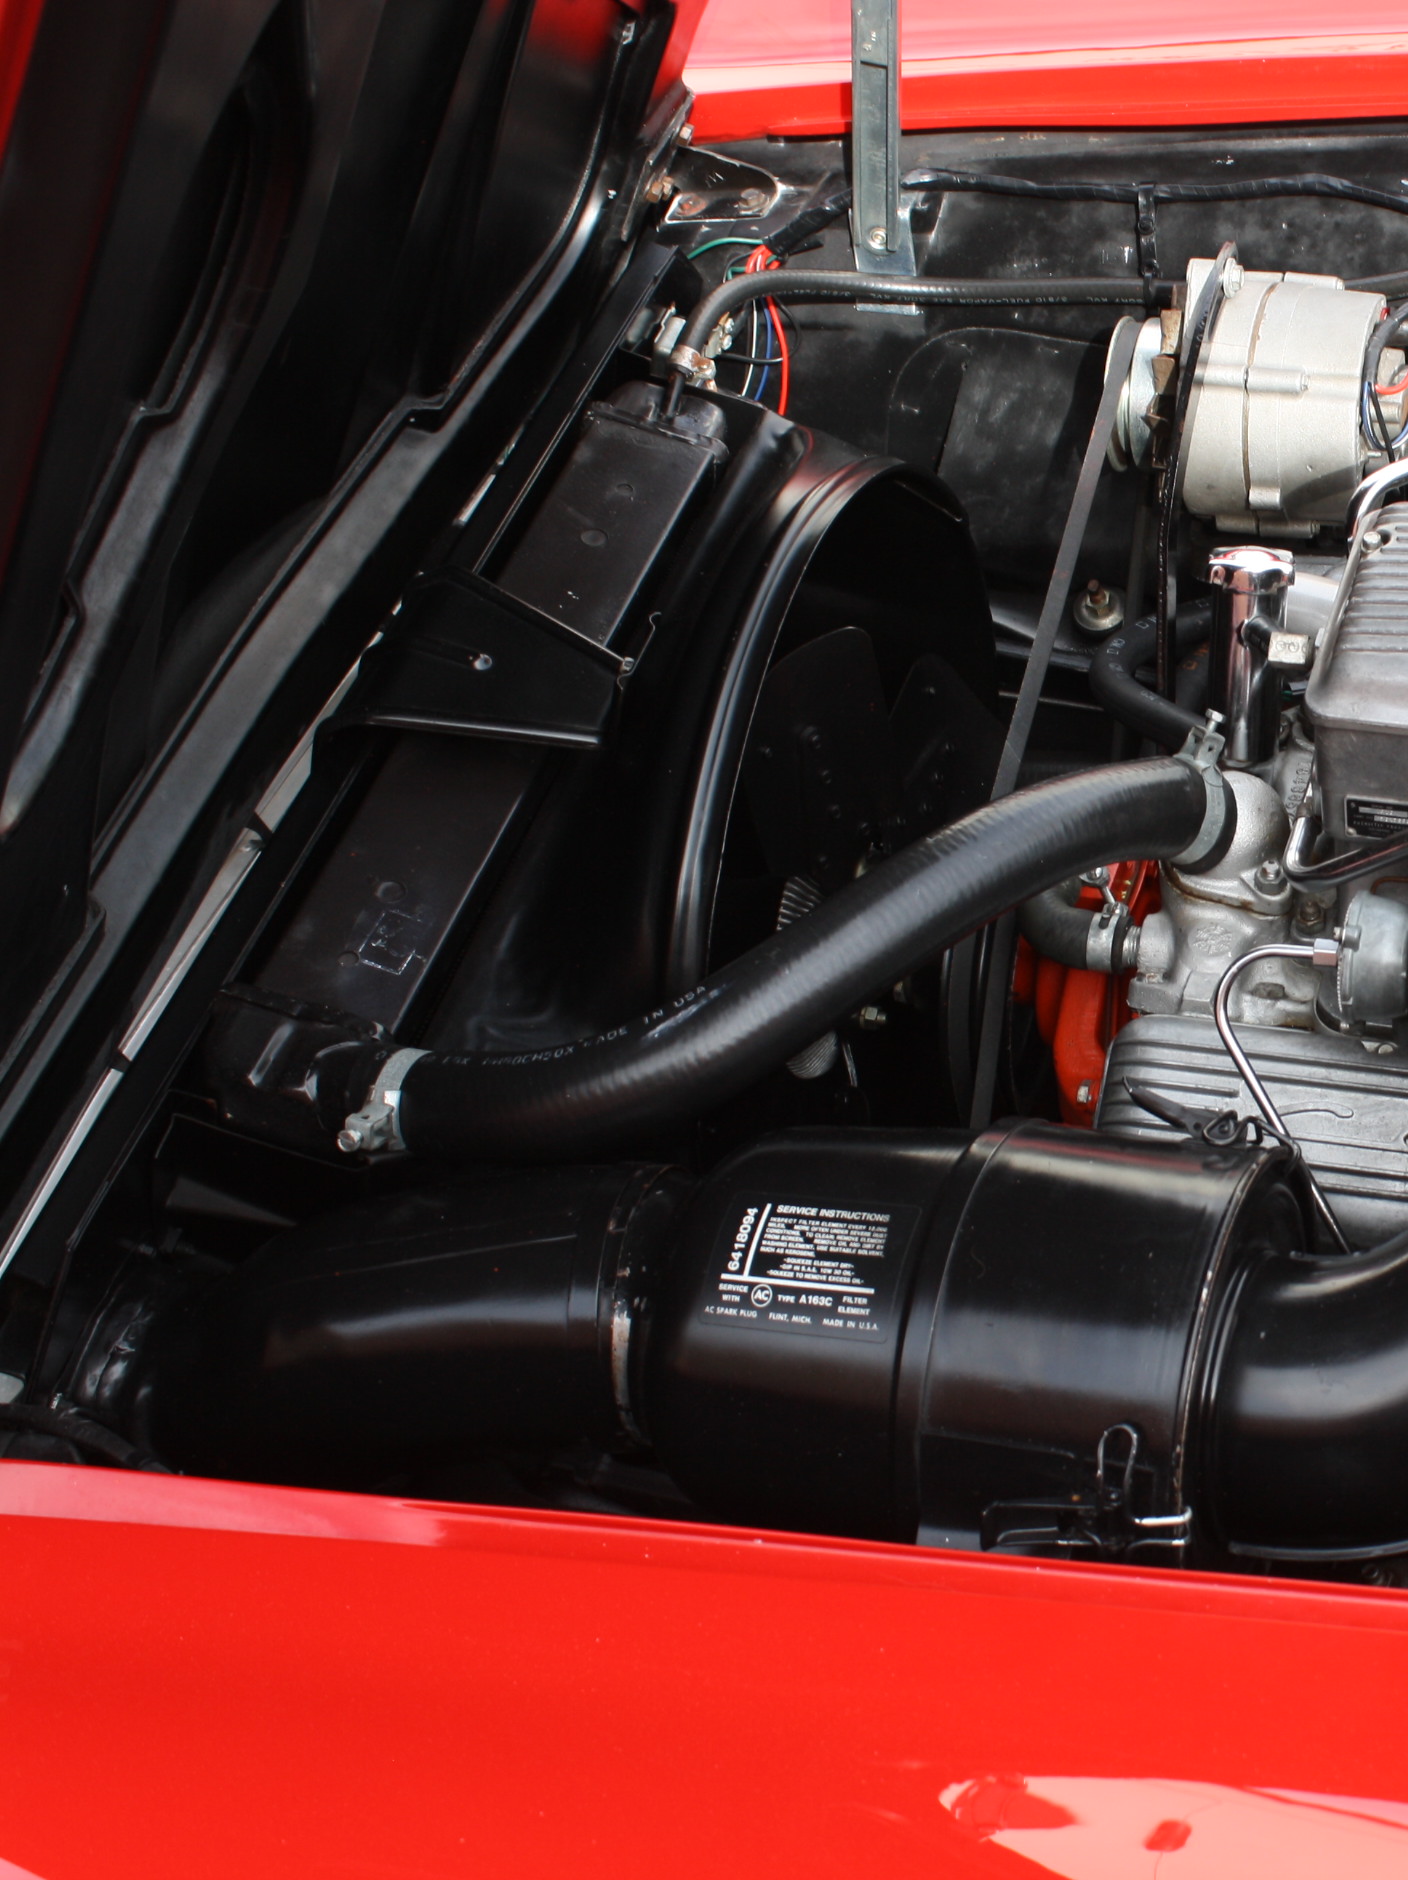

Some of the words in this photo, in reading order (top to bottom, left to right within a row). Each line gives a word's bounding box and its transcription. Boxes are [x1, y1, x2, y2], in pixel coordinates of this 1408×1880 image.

[643, 1008, 664, 1025] IN
[673, 985, 706, 1008] USA
[776, 1204, 818, 1217] SERVICE
[819, 1208, 891, 1222] INSTRUCTIONS
[770, 1216, 798, 1224] INSPECT
[798, 1218, 820, 1226] FILTER
[821, 1220, 847, 1229] ELEMENT
[718, 1283, 748, 1293] SERVICE
[721, 1293, 740, 1302] WITH
[753, 1289, 770, 1301] AC
[777, 1294, 795, 1303] TYPE
[799, 1295, 833, 1306] A163C
[842, 1295, 868, 1305] FILTER
[704, 1305, 715, 1314] AC
[716, 1306, 738, 1316] SPARK
[739, 1309, 758, 1318] PLUG
[791, 1315, 812, 1324] MICH.
[822, 1318, 844, 1328] MADE
[846, 1321, 855, 1329] IN
[837, 1306, 870, 1316] ELEMENT
